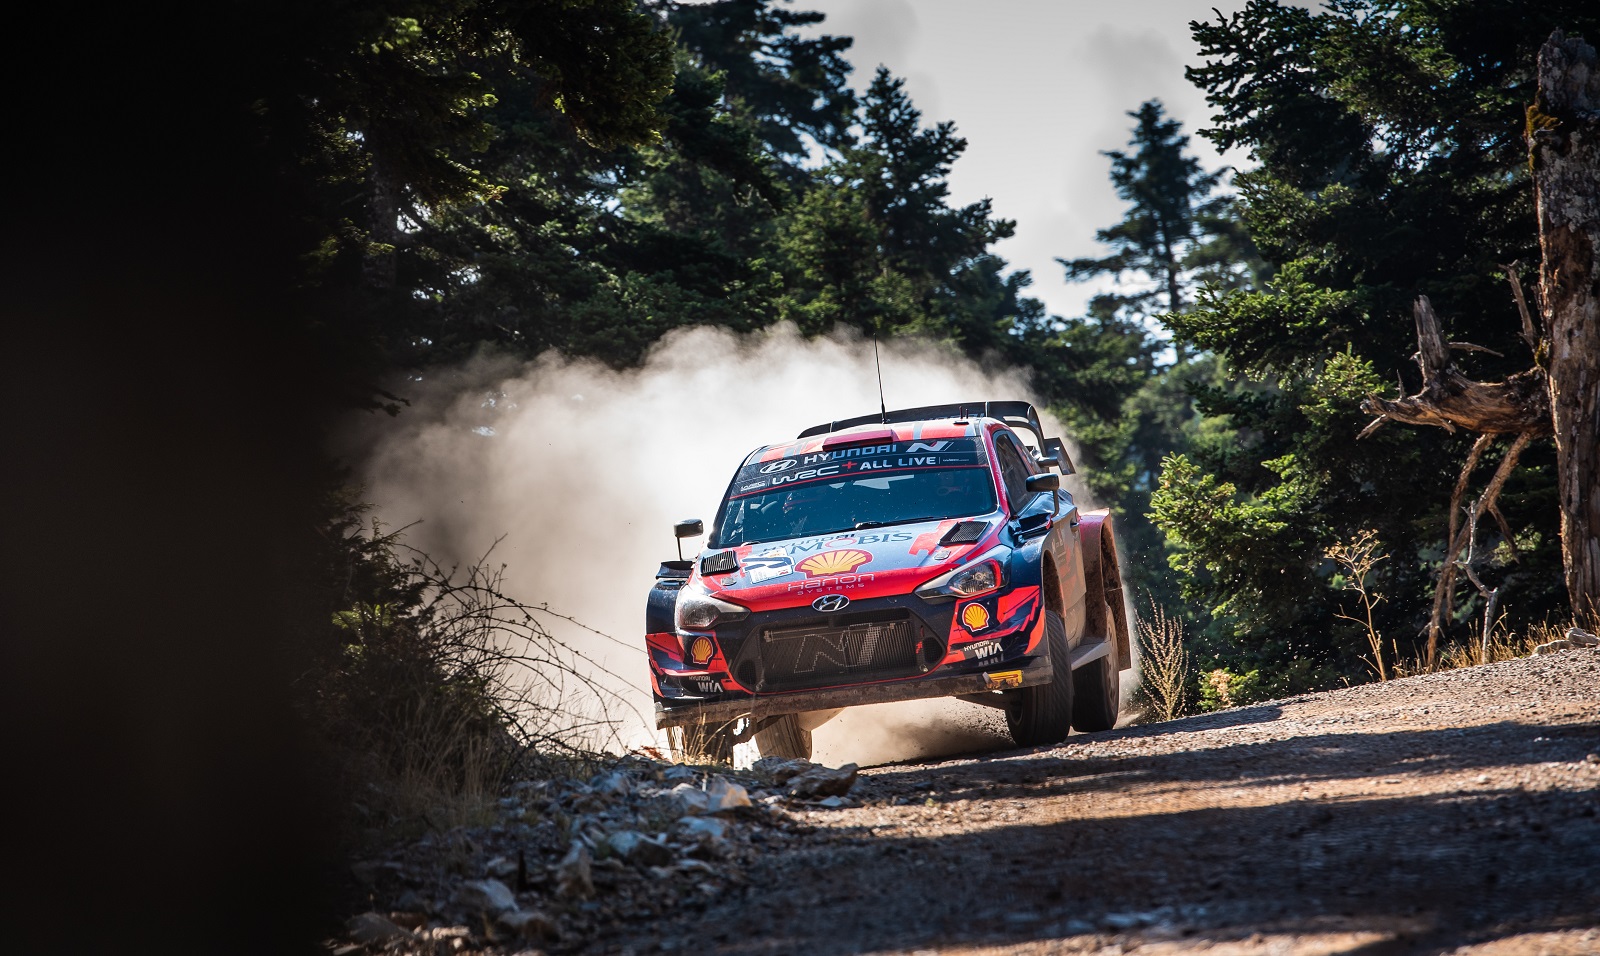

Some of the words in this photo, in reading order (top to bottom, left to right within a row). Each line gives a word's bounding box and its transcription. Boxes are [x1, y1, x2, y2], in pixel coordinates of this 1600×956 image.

[804, 444, 897, 464] HYUNDAI
[859, 459, 893, 471] ALL
[897, 456, 936, 467] LIVE
[789, 532, 913, 555] MOBIS
[797, 583, 865, 596] SYSTEMS
[963, 639, 990, 652] HYUNDAI
